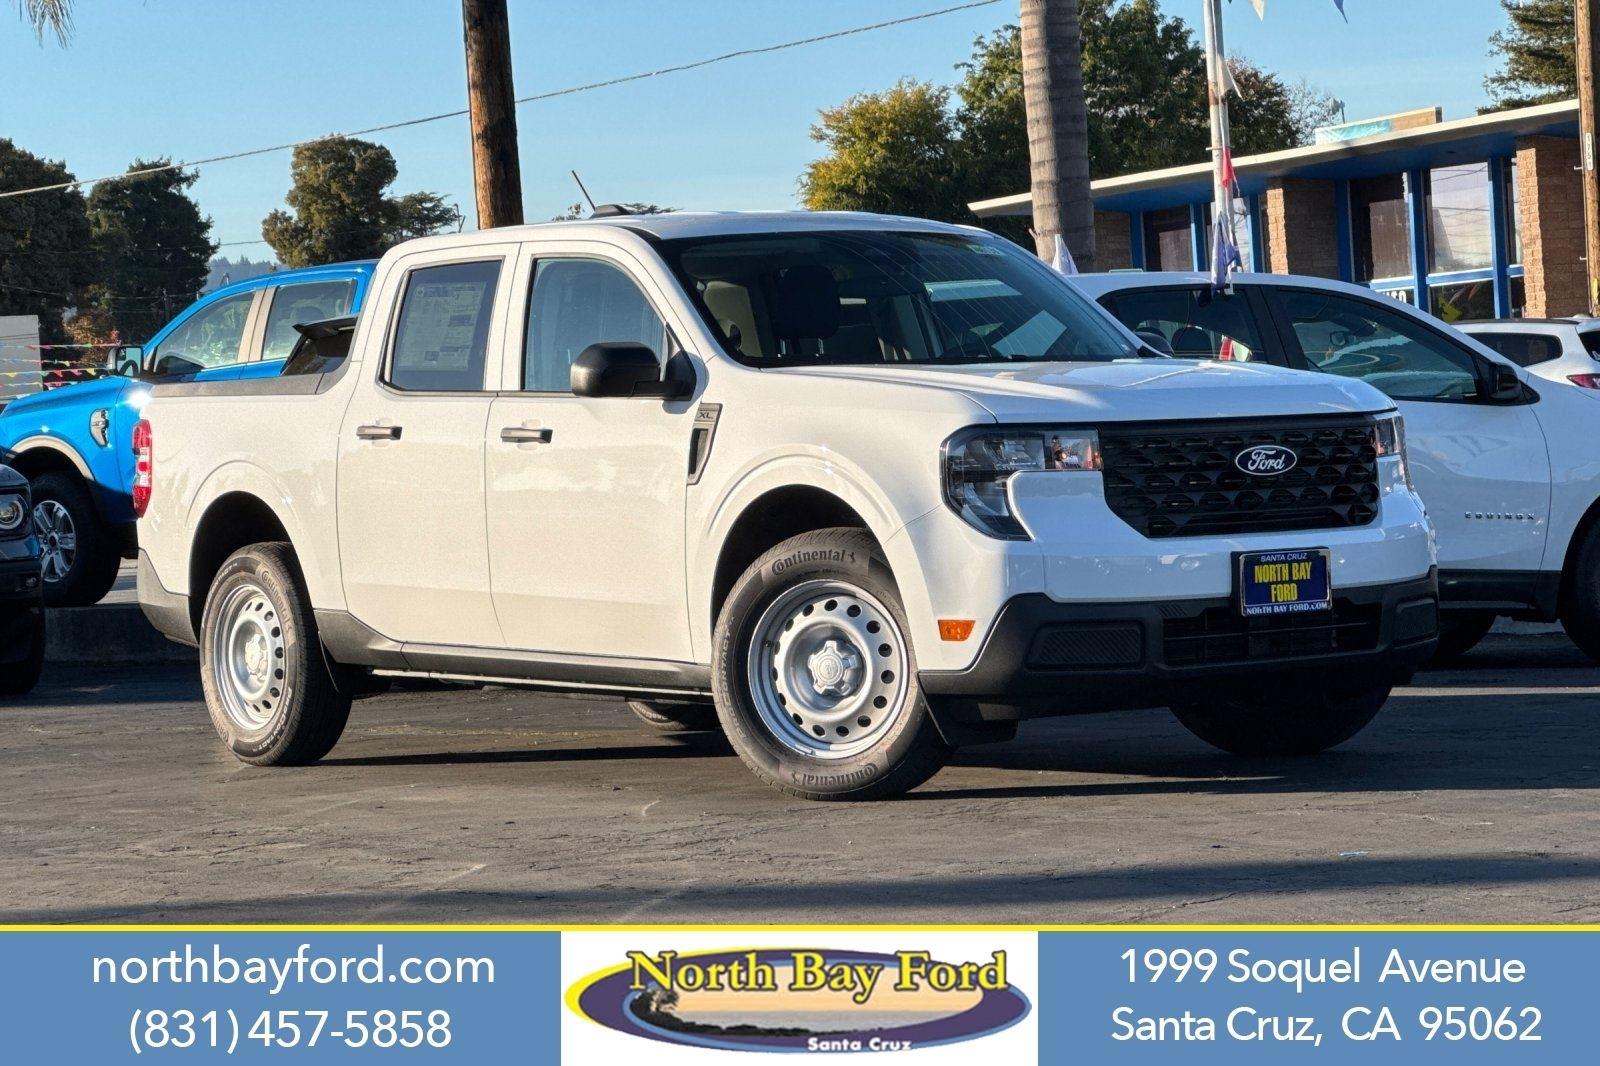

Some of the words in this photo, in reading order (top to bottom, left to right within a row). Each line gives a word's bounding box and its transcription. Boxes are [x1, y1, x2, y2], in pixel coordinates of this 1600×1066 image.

[699, 411, 714, 420] XL
[1247, 449, 1286, 471] Ford
[1464, 511, 1536, 520] EQUINOX
[771, 548, 847, 576] Continental
[1260, 553, 1285, 563] SANTA
[1286, 552, 1308, 562] CRUZ
[1254, 563, 1290, 583] NORTH
[1291, 561, 1312, 581] BAY
[1270, 582, 1298, 602] FORD
[1246, 605, 1272, 615] NORTH
[1273, 604, 1288, 614] BAY
[801, 762, 879, 787] Continental
